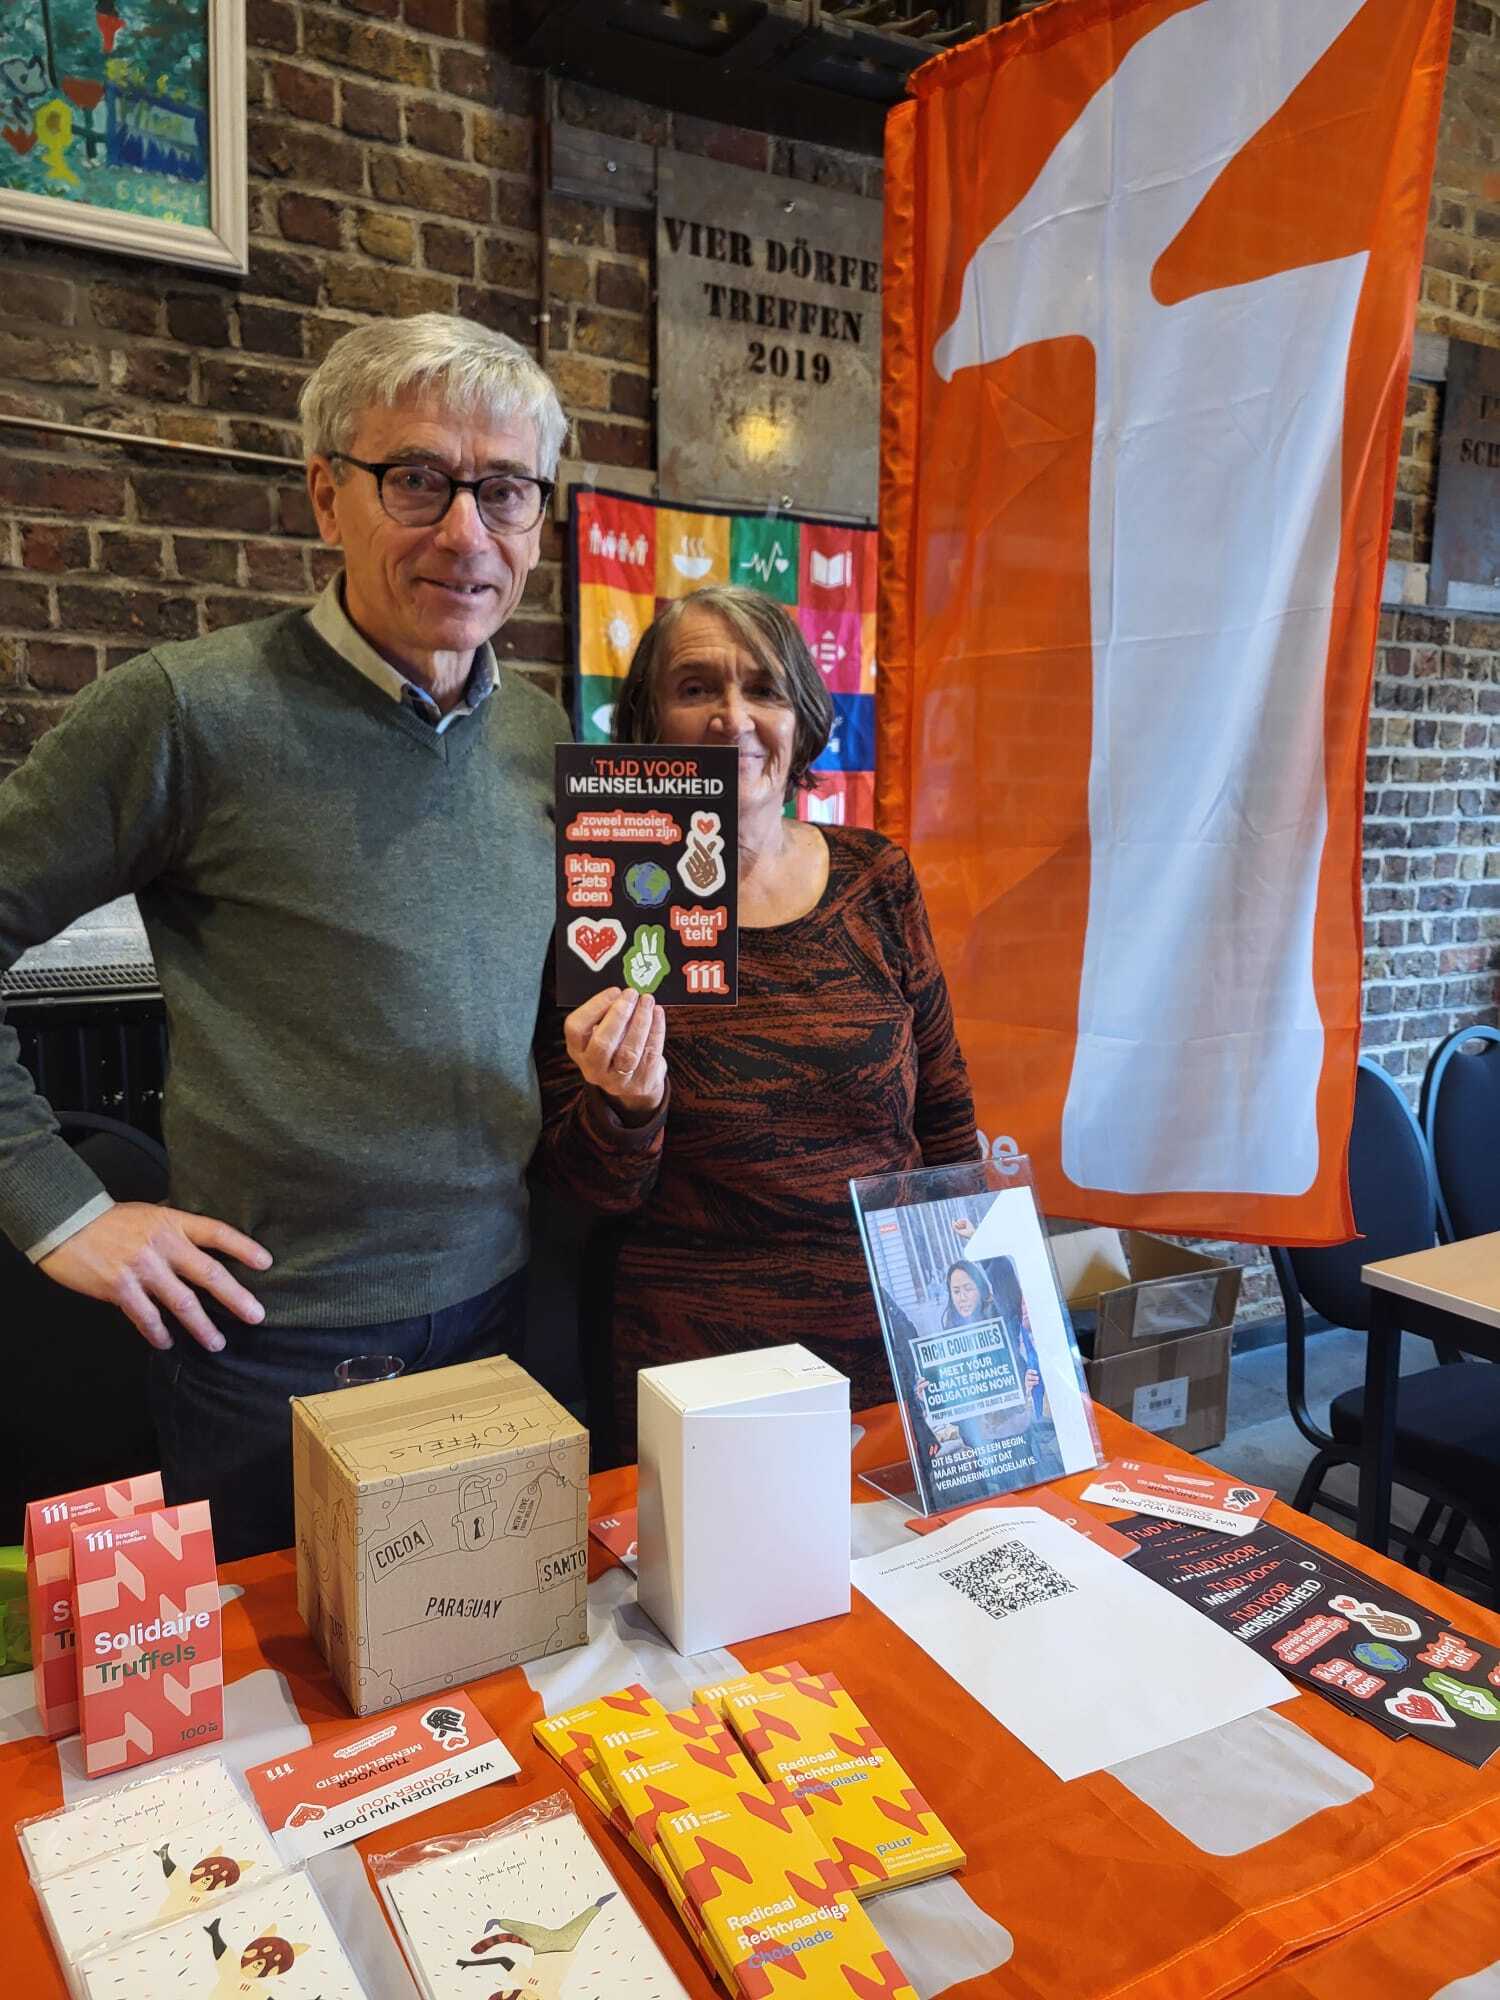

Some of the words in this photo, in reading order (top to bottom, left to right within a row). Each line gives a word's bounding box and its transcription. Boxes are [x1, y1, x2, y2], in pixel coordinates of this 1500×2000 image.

[664, 216, 753, 267] VIER
[766, 236, 881, 293] DÖRFE
[703, 282, 863, 343] TREFFEN
[749, 341, 831, 385] 2019
[643, 761, 698, 777] VOOR
[572, 826, 589, 837] als
[592, 828, 610, 837] we
[612, 828, 653, 837] samen
[656, 827, 677, 840] zijn
[582, 815, 621, 826] zoveel
[624, 816, 667, 826] mooier
[584, 859, 610, 873] kan
[573, 889, 608, 902] doen
[685, 927, 713, 941] telt
[921, 1342, 946, 1363] RICH
[946, 1328, 1001, 1356] COUNTRIES
[927, 1373, 969, 1394] CLIMATE
[969, 1363, 1010, 1383] FINANCE
[939, 1362, 965, 1377] MEET
[966, 1356, 993, 1370] YOUR
[928, 1383, 989, 1406] OBLIGATIONS
[989, 1375, 1016, 1388] NOW!
[389, 1417, 540, 1459] TRUFFELS
[931, 1457, 945, 1468] DIT
[945, 1456, 953, 1464] IS
[953, 1446, 986, 1463] SLECHTS
[986, 1442, 1002, 1453] EEN
[933, 1466, 957, 1480] MAAR
[958, 1462, 973, 1472] HET
[974, 1456, 999, 1469] TOONT
[998, 1450, 1013, 1461] DAT
[936, 1469, 990, 1491] VERANDERING
[990, 1460, 1027, 1476] MOGELIJK
[375, 1531, 426, 1569] COCOA
[1215, 1545, 1261, 1564] VOOR
[544, 1550, 586, 1581] SANTO
[425, 1596, 503, 1619] PARAGUAY
[1260, 1582, 1294, 1609] VOOR
[94, 1611, 210, 1655] Solidaire
[1279, 1634, 1302, 1653] zoveel
[96, 1643, 196, 1684] Truffels
[1327, 1662, 1348, 1676] kan
[1447, 1648, 1473, 1667] telt
[1353, 1675, 1380, 1695] doen
[181, 1724, 207, 1740] 100
[465, 1762, 495, 1779] WAT
[777, 1749, 838, 1773] Radicaal
[785, 1754, 884, 1785] Rechtvaardige
[338, 1770, 378, 1789] VOOR
[394, 1768, 455, 1798] ZONDER
[402, 1773, 462, 1805] ZOUDEN
[357, 1793, 393, 1814] JOU!
[323, 1814, 368, 1838] DOEN
[876, 1836, 912, 1856] puur
[726, 1896, 797, 1931] Radicaal
[737, 1903, 850, 1950] Rechtvaardige
